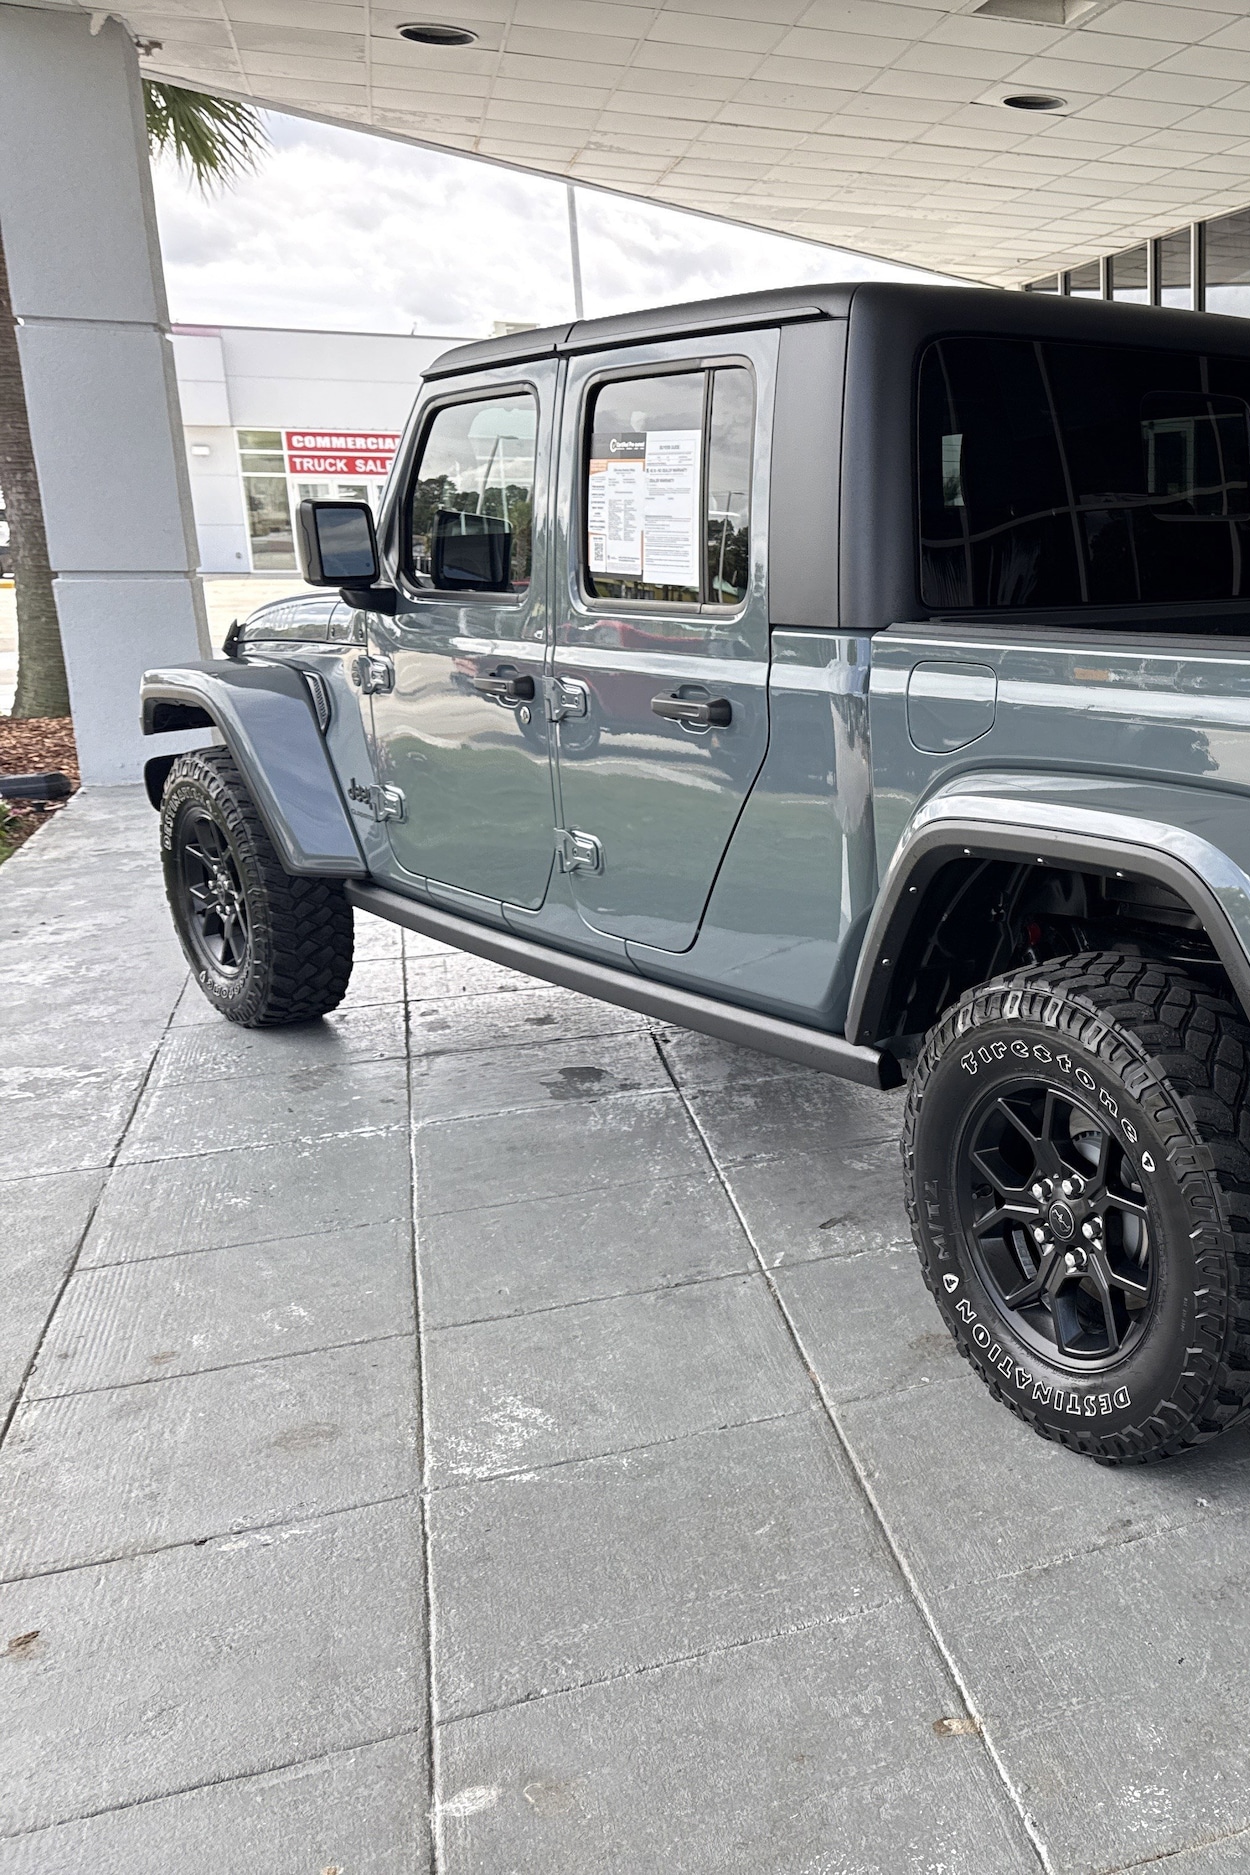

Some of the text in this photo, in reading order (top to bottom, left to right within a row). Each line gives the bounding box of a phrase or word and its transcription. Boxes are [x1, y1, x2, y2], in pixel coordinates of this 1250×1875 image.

[292, 457, 348, 472] TRUCK
[961, 1039, 1138, 1144] Firestone
[956, 1298, 1132, 1417] DESTINATION
